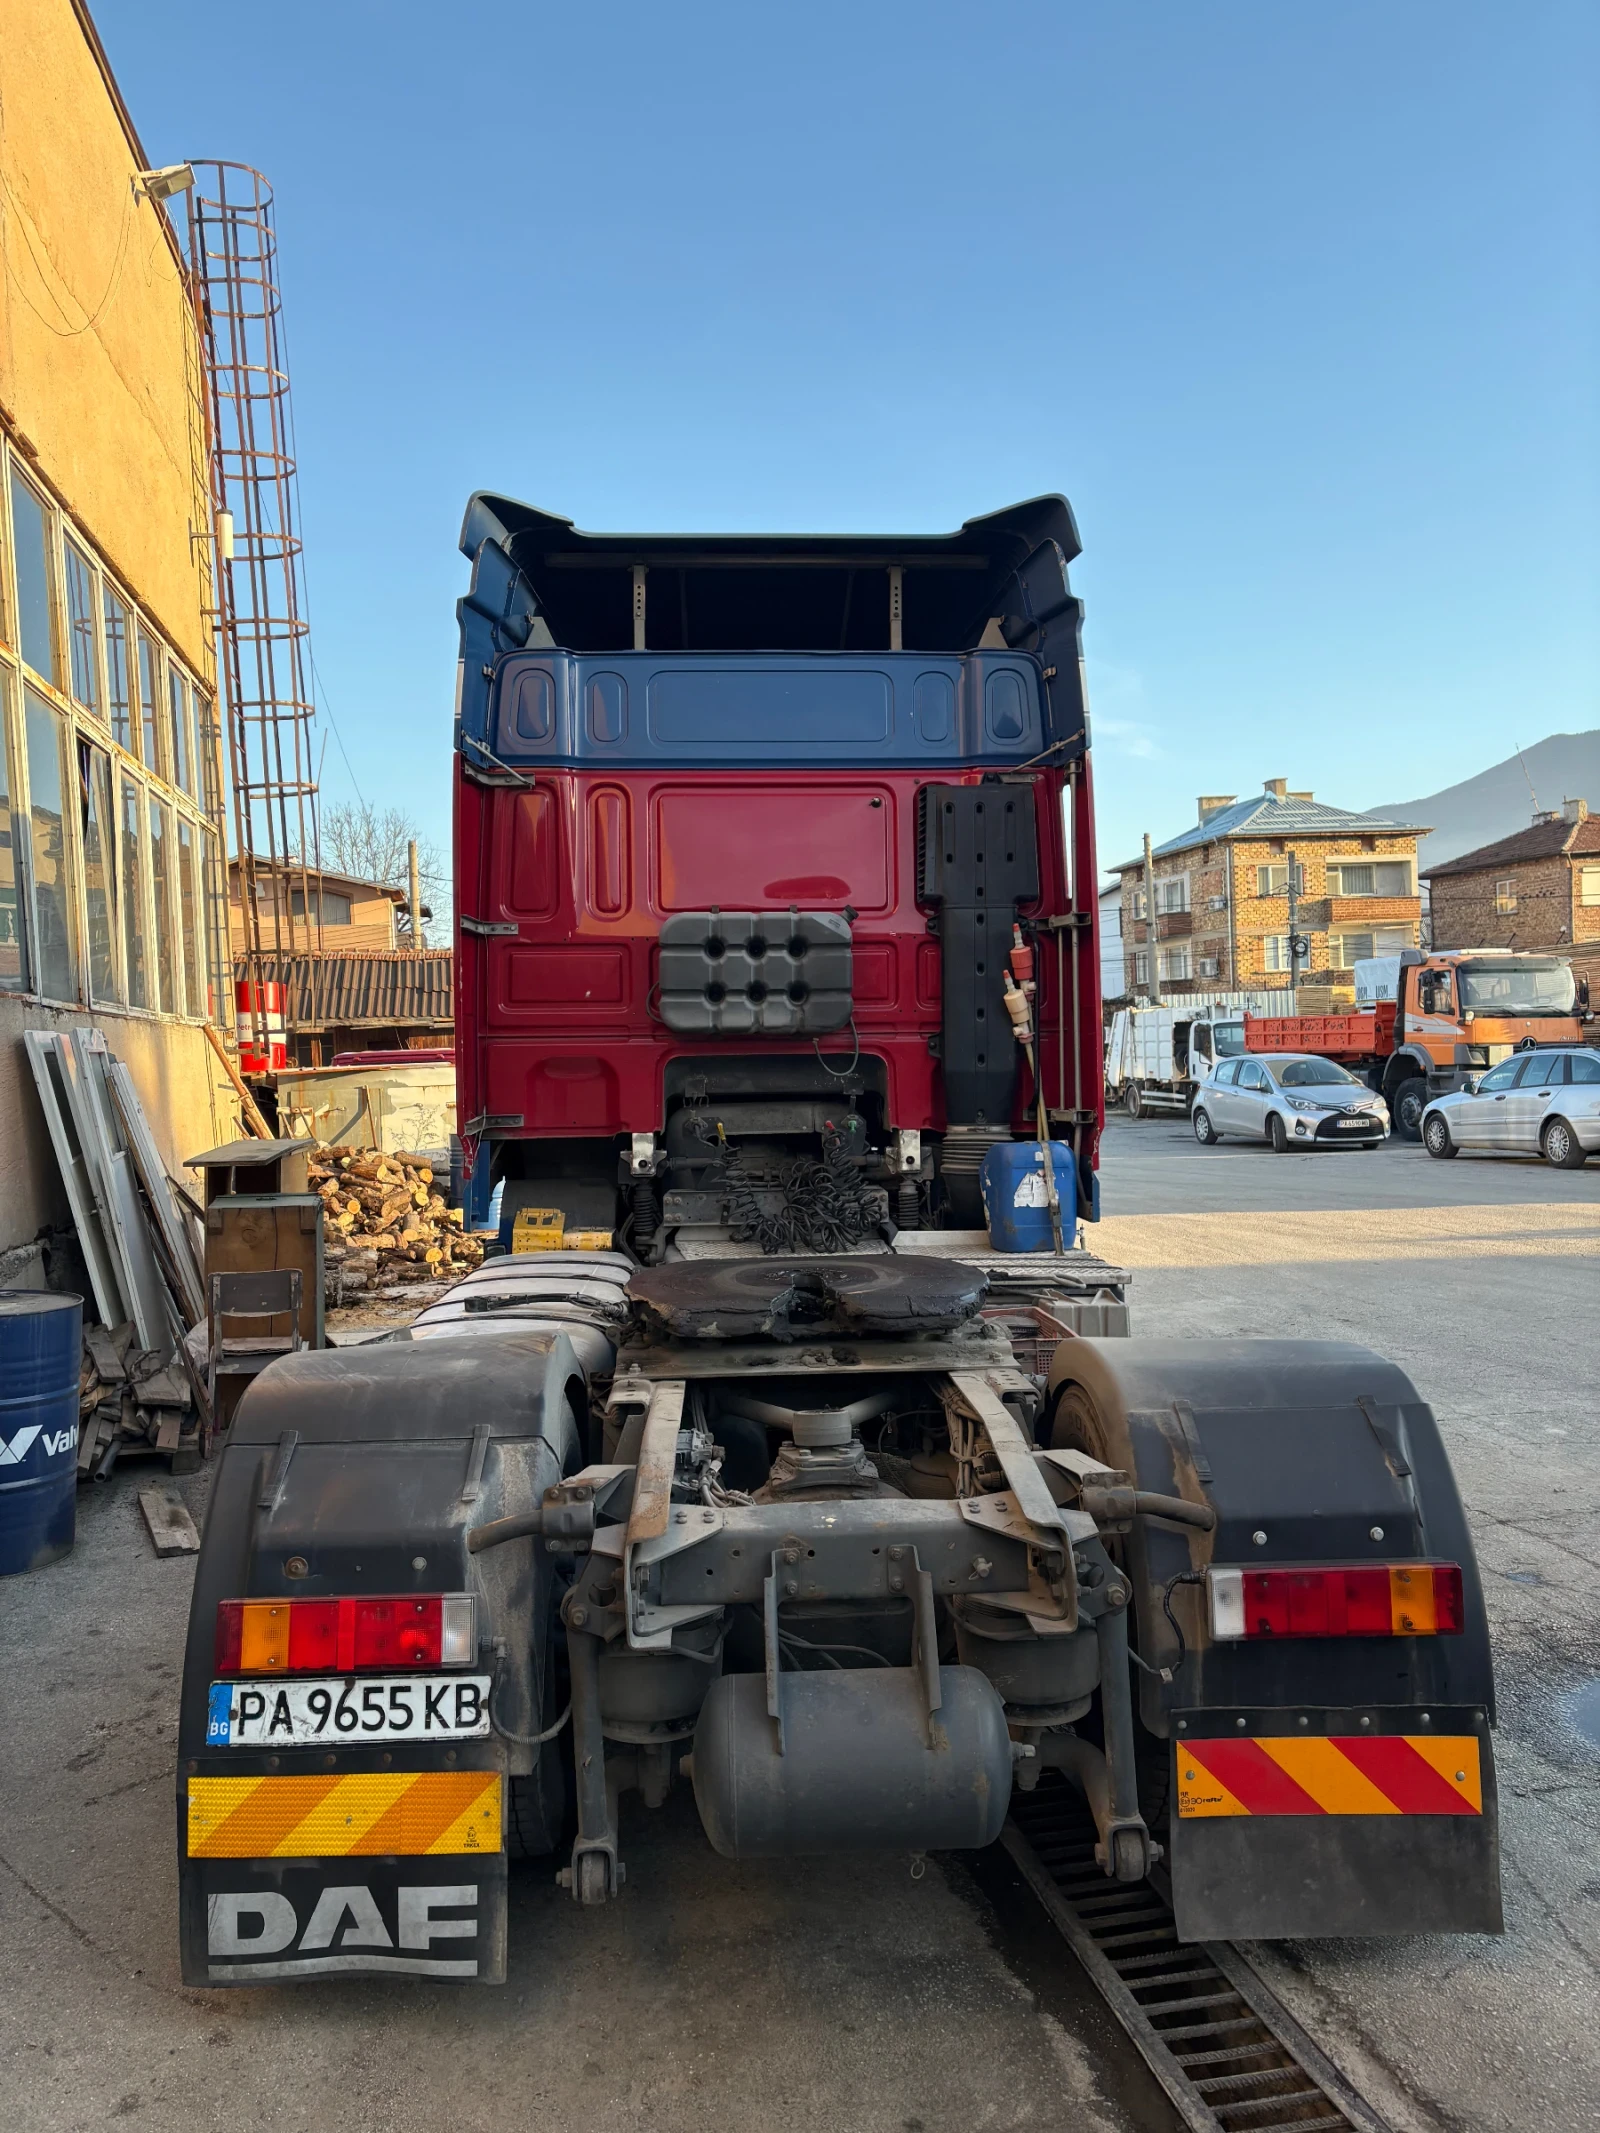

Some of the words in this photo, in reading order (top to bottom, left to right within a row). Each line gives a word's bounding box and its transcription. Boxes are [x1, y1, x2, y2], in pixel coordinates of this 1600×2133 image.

[209, 1721, 229, 1737] BG
[237, 1689, 295, 1736] PA
[307, 1685, 414, 1733] 9655
[424, 1682, 482, 1729] KB
[207, 1884, 478, 1956] DAF
